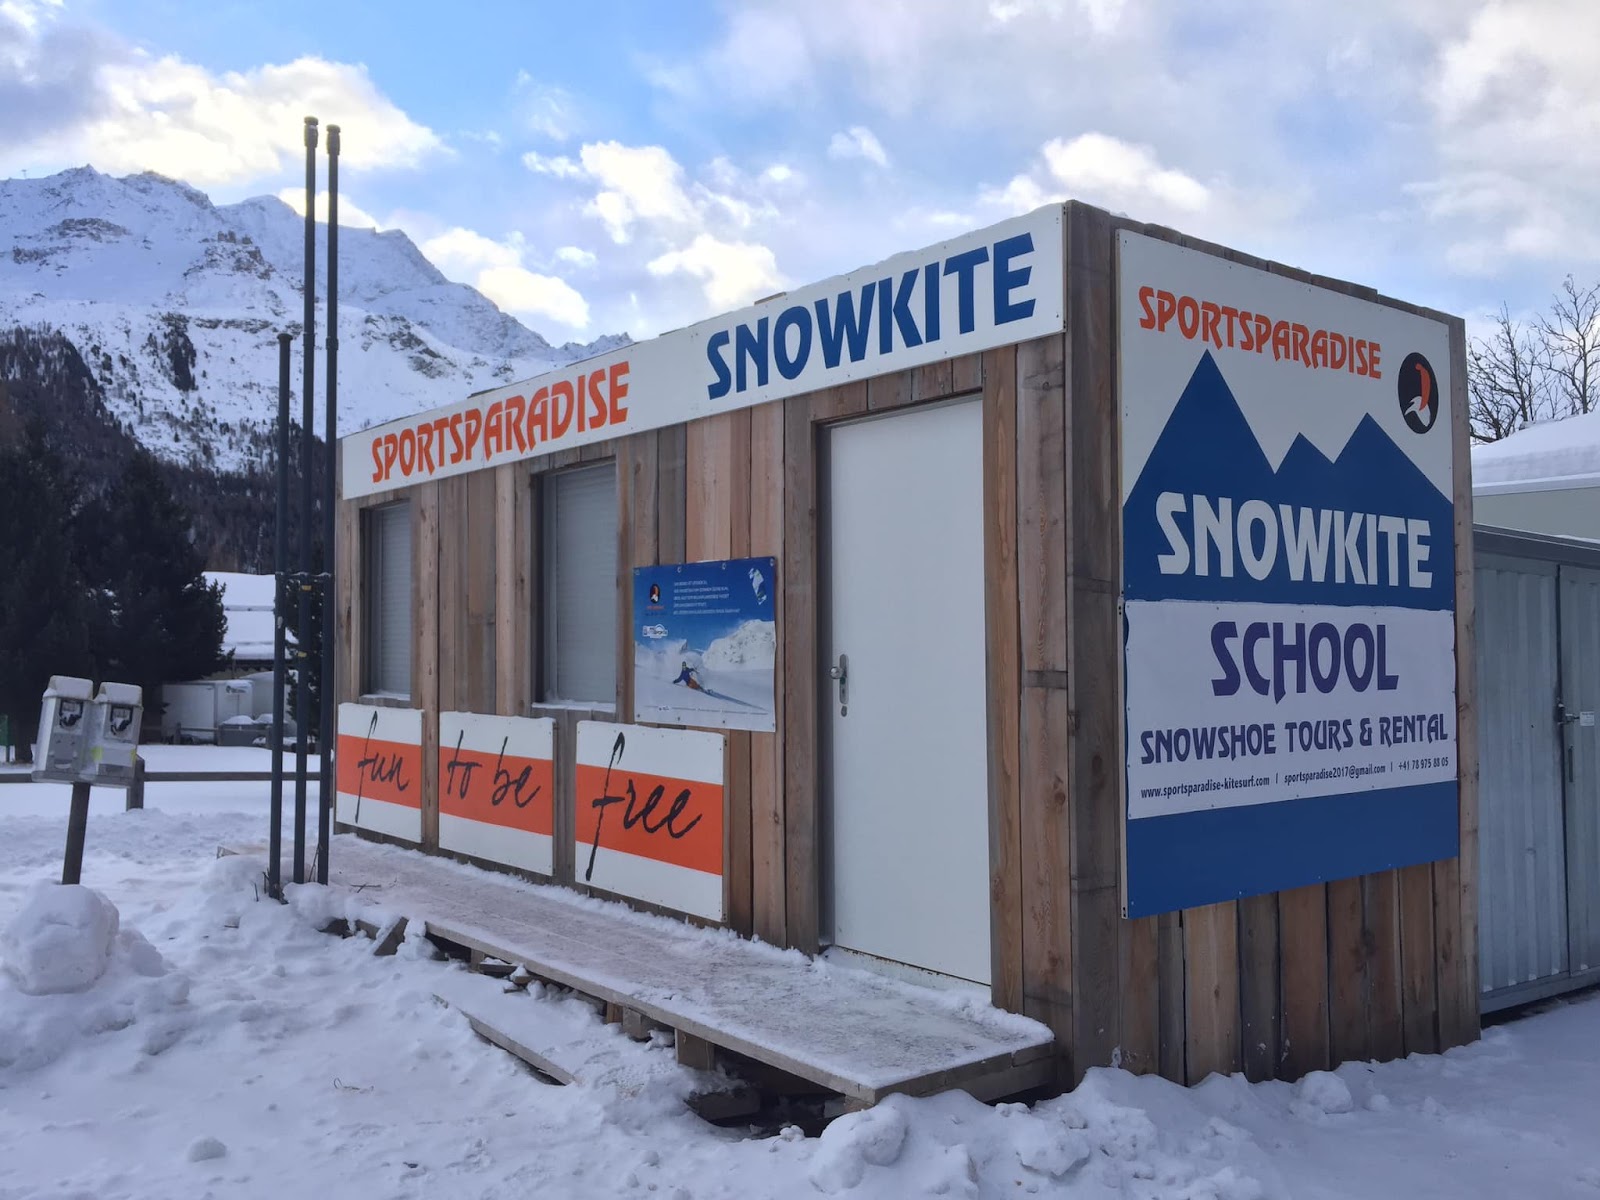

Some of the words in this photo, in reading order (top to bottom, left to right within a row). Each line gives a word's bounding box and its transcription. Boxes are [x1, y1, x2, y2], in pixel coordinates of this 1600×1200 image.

[371, 360, 631, 482] SPORTSPARADISE
[707, 232, 1036, 400] SNOWKITE
[1138, 285, 1382, 379] SPORTSPARADISE
[1155, 491, 1433, 588] SNOWKITE
[1210, 621, 1399, 705] SCHOOL
[354, 710, 410, 824] fun
[447, 729, 483, 799] to
[492, 735, 542, 809] be
[1140, 723, 1276, 765] SNOWSHOE
[1285, 718, 1353, 752] TOURS
[1359, 717, 1373, 746] &
[1379, 713, 1448, 748] RENTAL
[1140, 774, 1270, 799] www.sportsparadise-kitesurf.com
[1284, 763, 1386, 786] sportsparadise2017@gmail.com
[1398, 759, 1411, 772] +41
[1412, 759, 1420, 770] 78
[1421, 758, 1432, 769] 975
[1433, 757, 1441, 768] 88
[1442, 757, 1449, 767] 05
[585, 731, 703, 882] free
